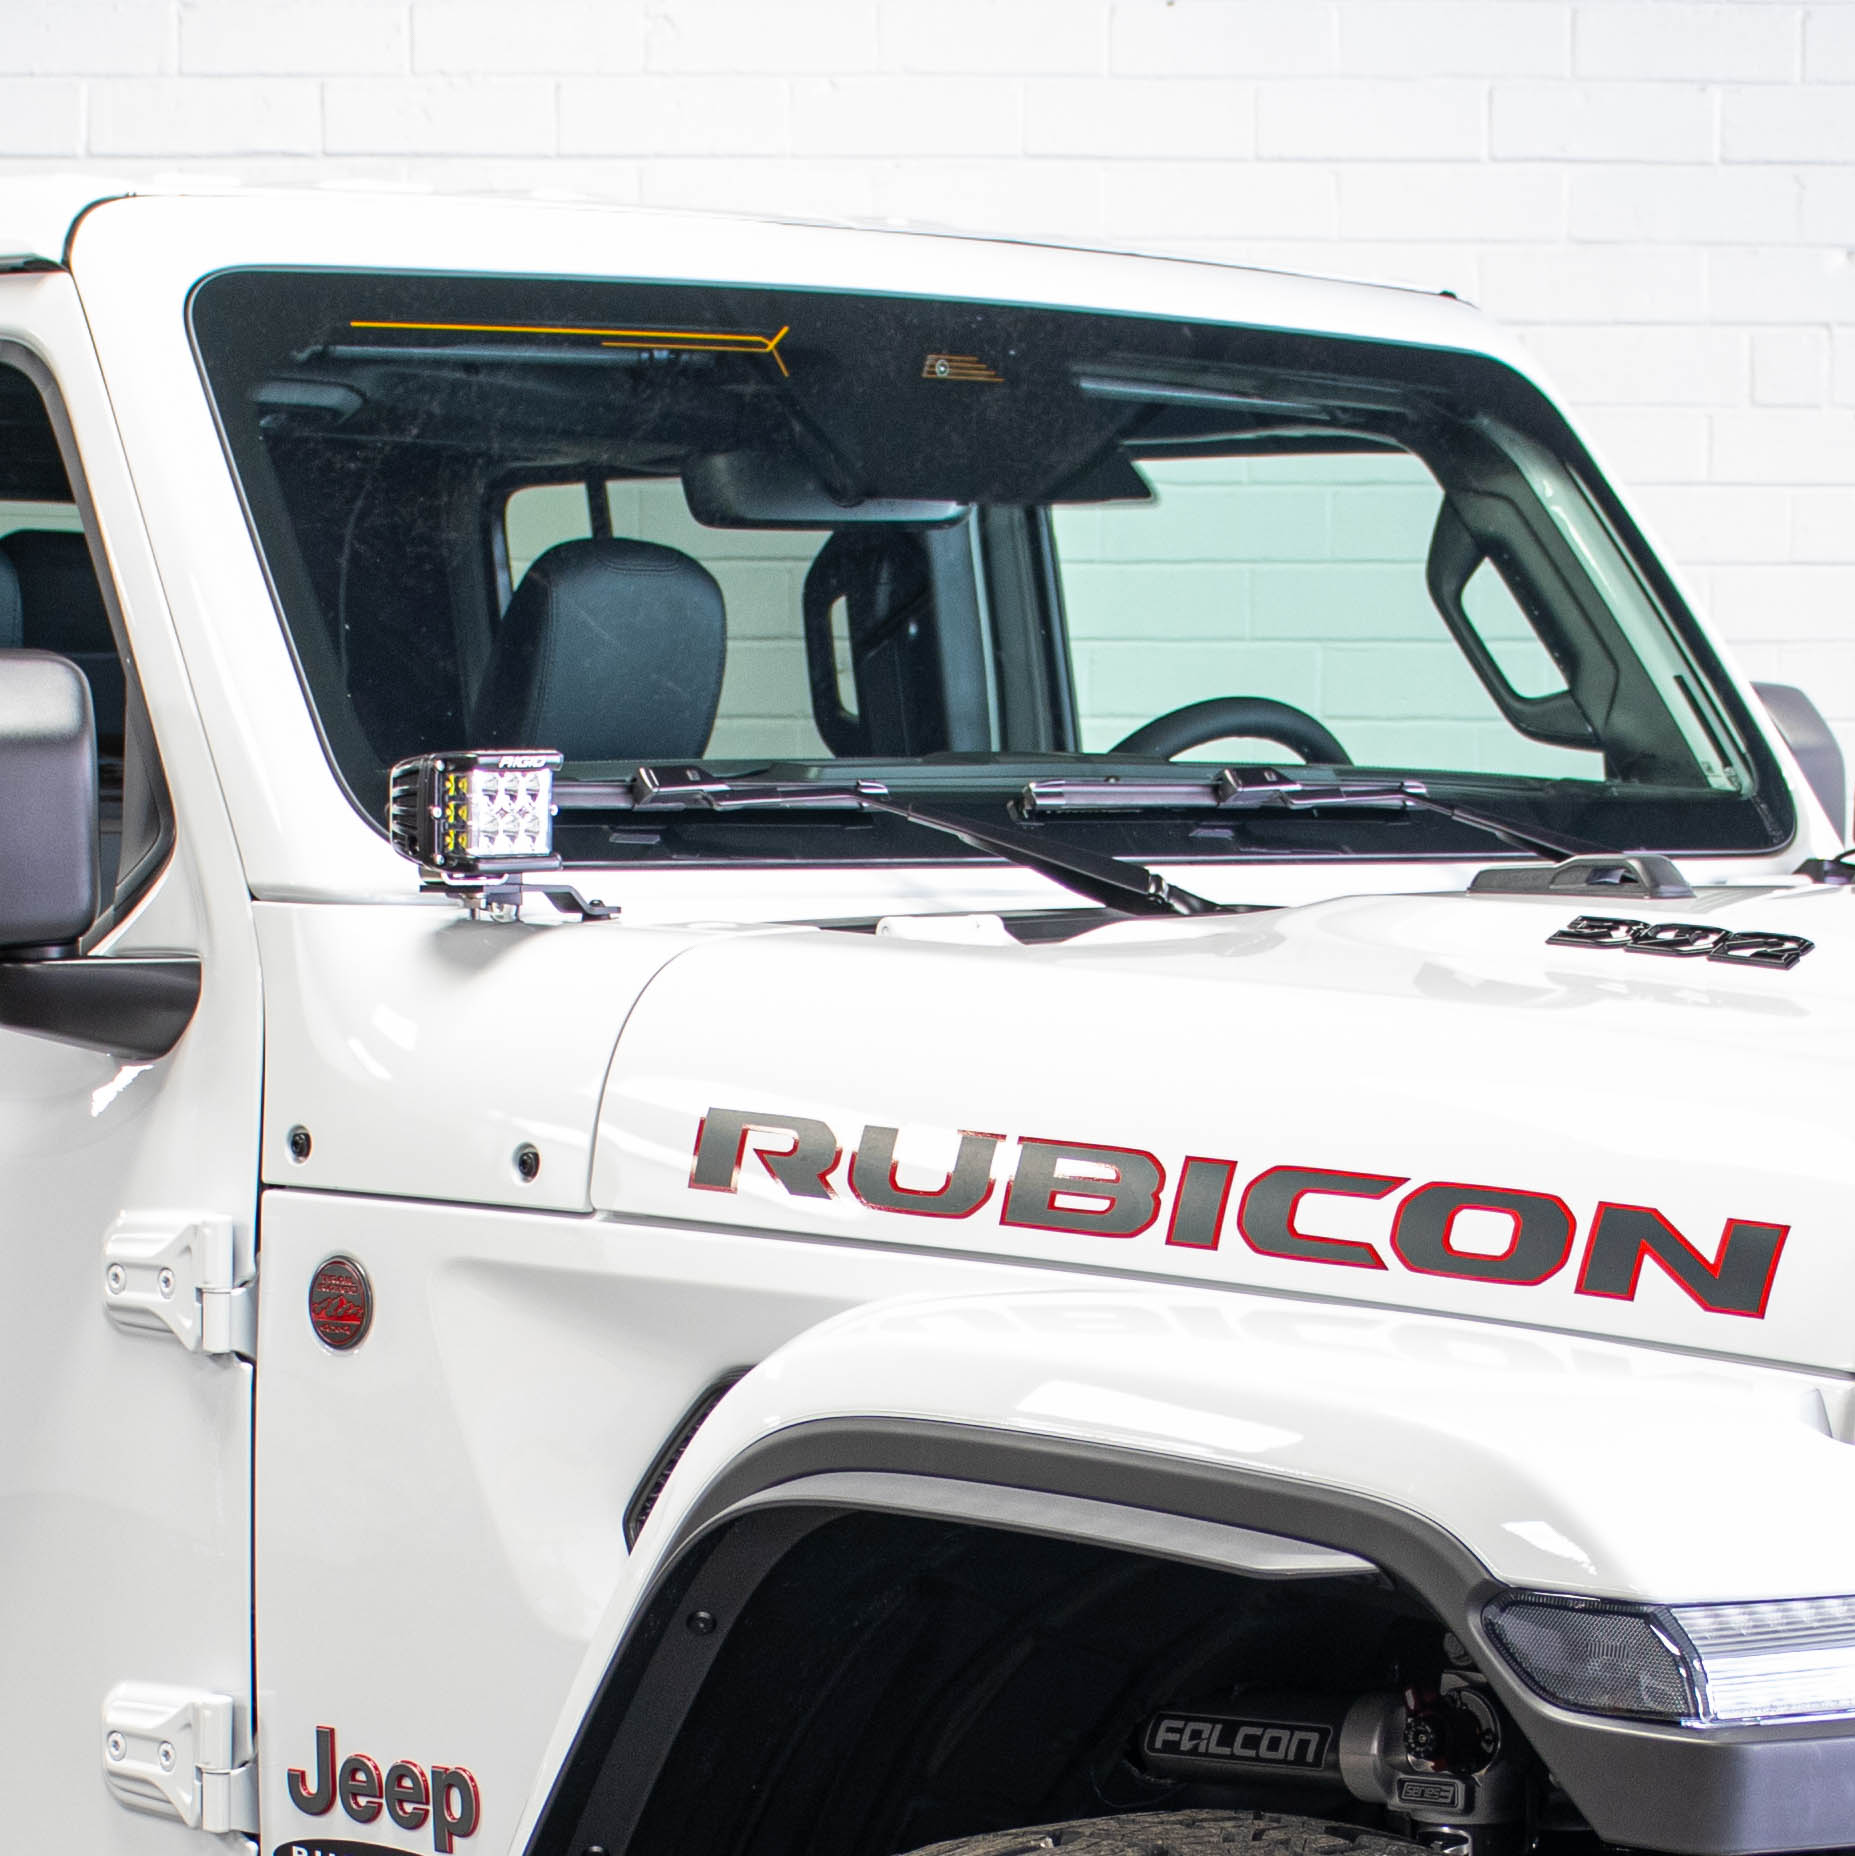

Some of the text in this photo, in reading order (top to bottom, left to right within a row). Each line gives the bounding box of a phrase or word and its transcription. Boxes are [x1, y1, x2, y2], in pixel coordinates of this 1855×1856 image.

[687, 1106, 1792, 1320] RUBICON
[287, 1725, 482, 1855] Jeep
[1153, 1718, 1321, 1765] FALCON
